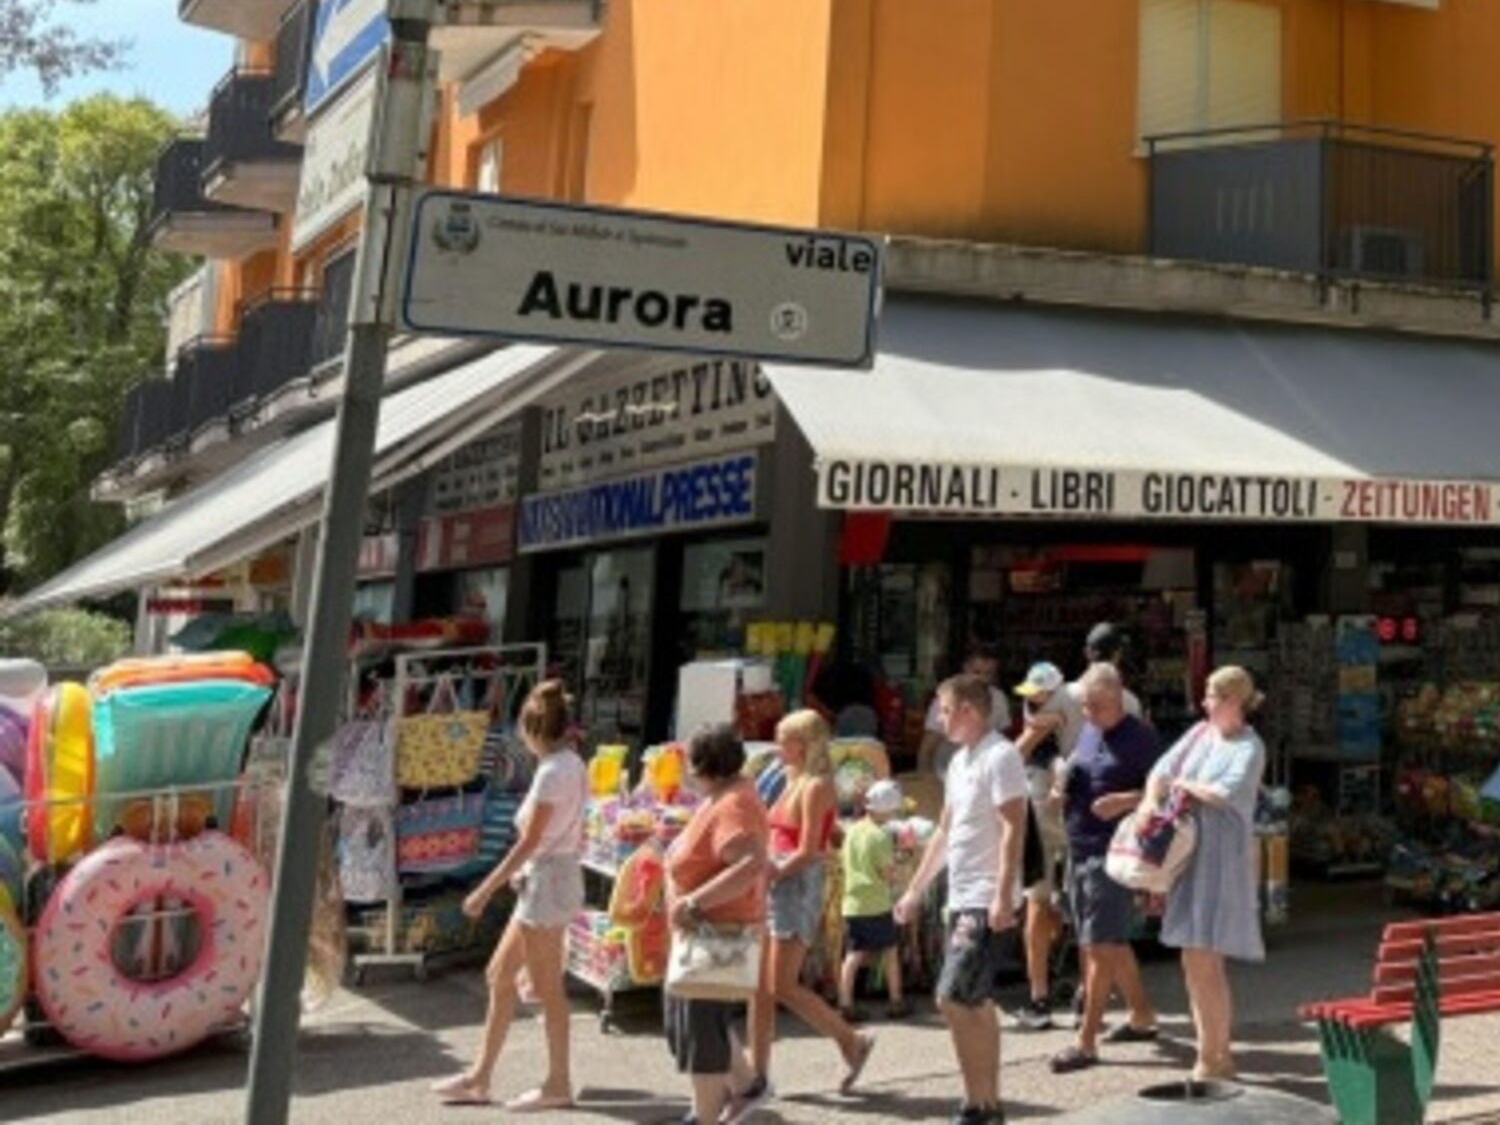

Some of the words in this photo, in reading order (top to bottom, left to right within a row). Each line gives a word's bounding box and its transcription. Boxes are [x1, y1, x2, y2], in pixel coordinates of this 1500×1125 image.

[785, 237, 871, 272] viale
[516, 270, 733, 334] Aurora
[826, 461, 999, 508] GIORNALI
[1030, 469, 1116, 512] LIBRI
[1141, 473, 1318, 517] GIOCATTOLI
[1340, 480, 1491, 521] ZEITUNGEN
